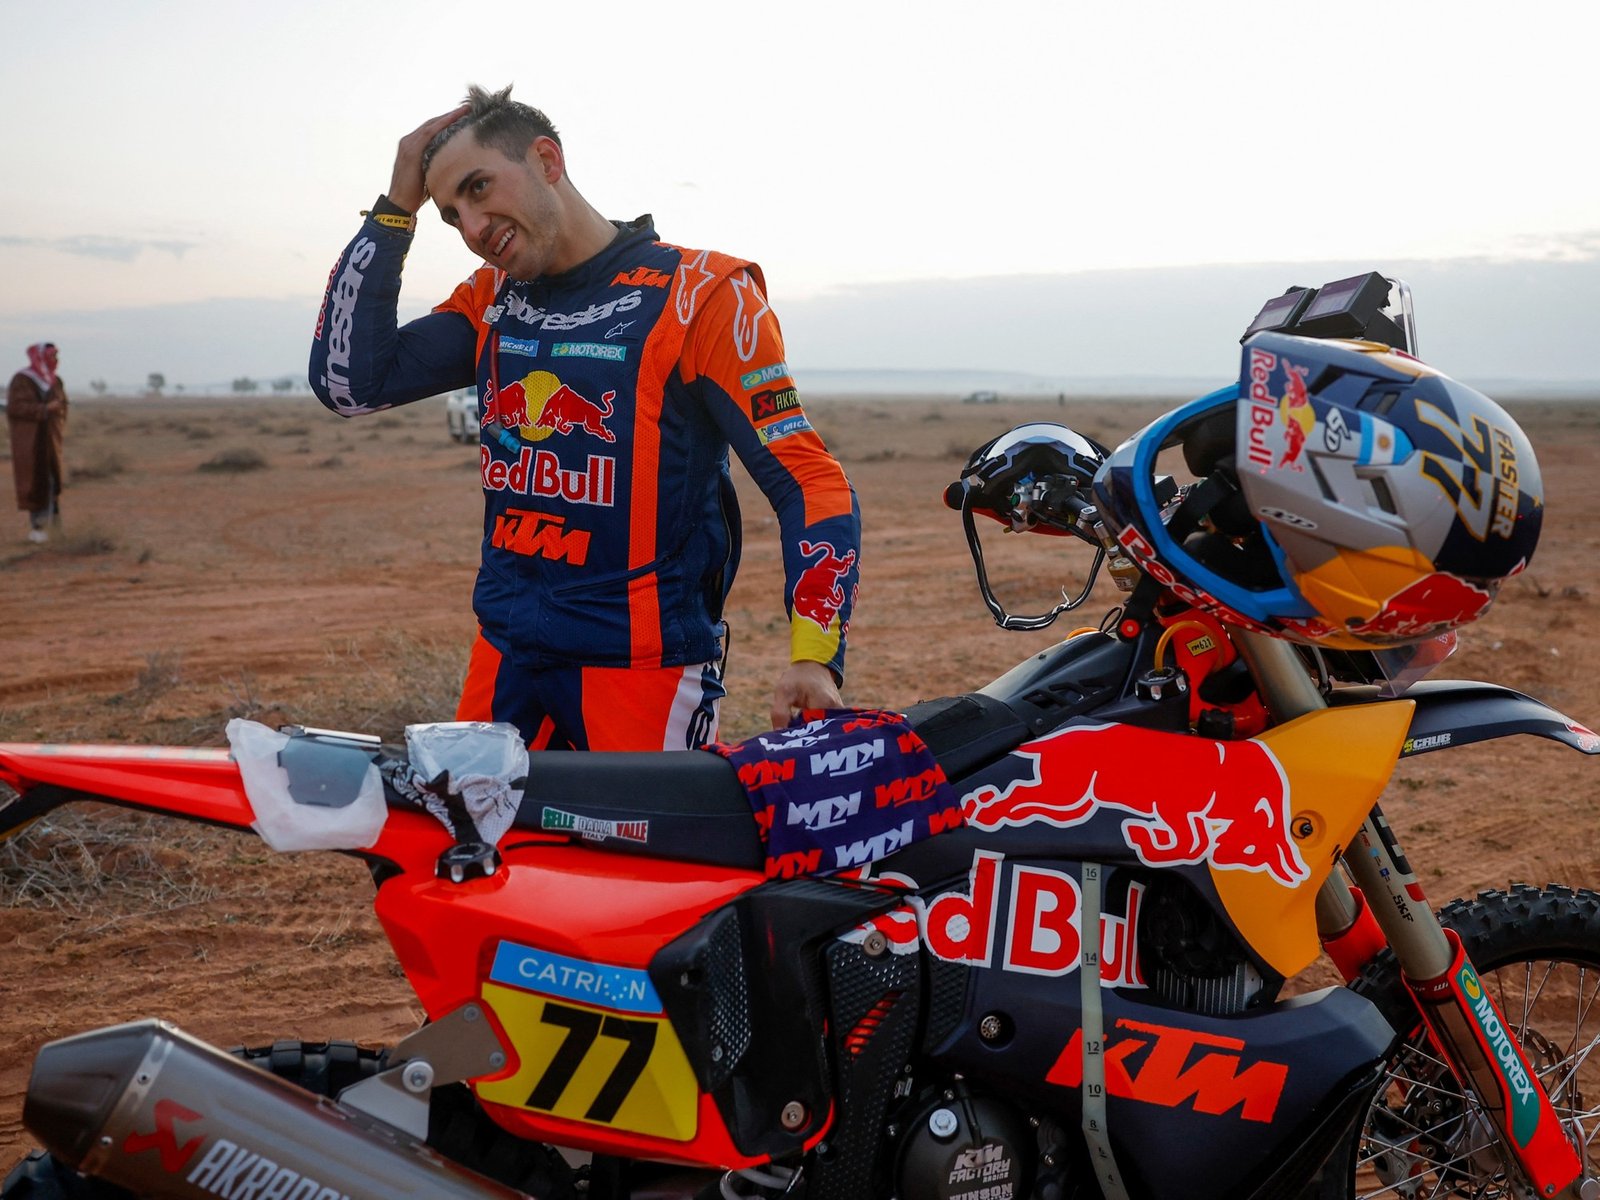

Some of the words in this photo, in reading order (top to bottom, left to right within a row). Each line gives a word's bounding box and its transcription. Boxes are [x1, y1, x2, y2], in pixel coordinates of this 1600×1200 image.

[608, 266, 672, 288] KTM
[568, 344, 622, 359] MOTOREX
[1250, 348, 1278, 406] Red
[1247, 404, 1275, 466] Bull
[480, 444, 533, 495] Red
[532, 450, 616, 507] Bull
[491, 508, 592, 566] KTM
[810, 739, 885, 778] KTM
[875, 763, 948, 810] KTM
[616, 821, 648, 842] VALLE
[787, 791, 862, 832] KTM
[834, 819, 914, 869] KTM
[1085, 868, 1097, 878] 16
[837, 850, 1004, 969] ed
[1003, 864, 1150, 989] Bul
[1392, 894, 1414, 922] SKF
[1085, 952, 1097, 963] 14
[524, 1002, 659, 1124] 77
[1086, 1041, 1100, 1052] 12
[1475, 996, 1534, 1105] MOTOREX
[1045, 1018, 1289, 1124] KTM
[1087, 1084, 1101, 1094] 10
[948, 1158, 1011, 1185] FACTORY
[954, 1143, 1004, 1170] KTM
